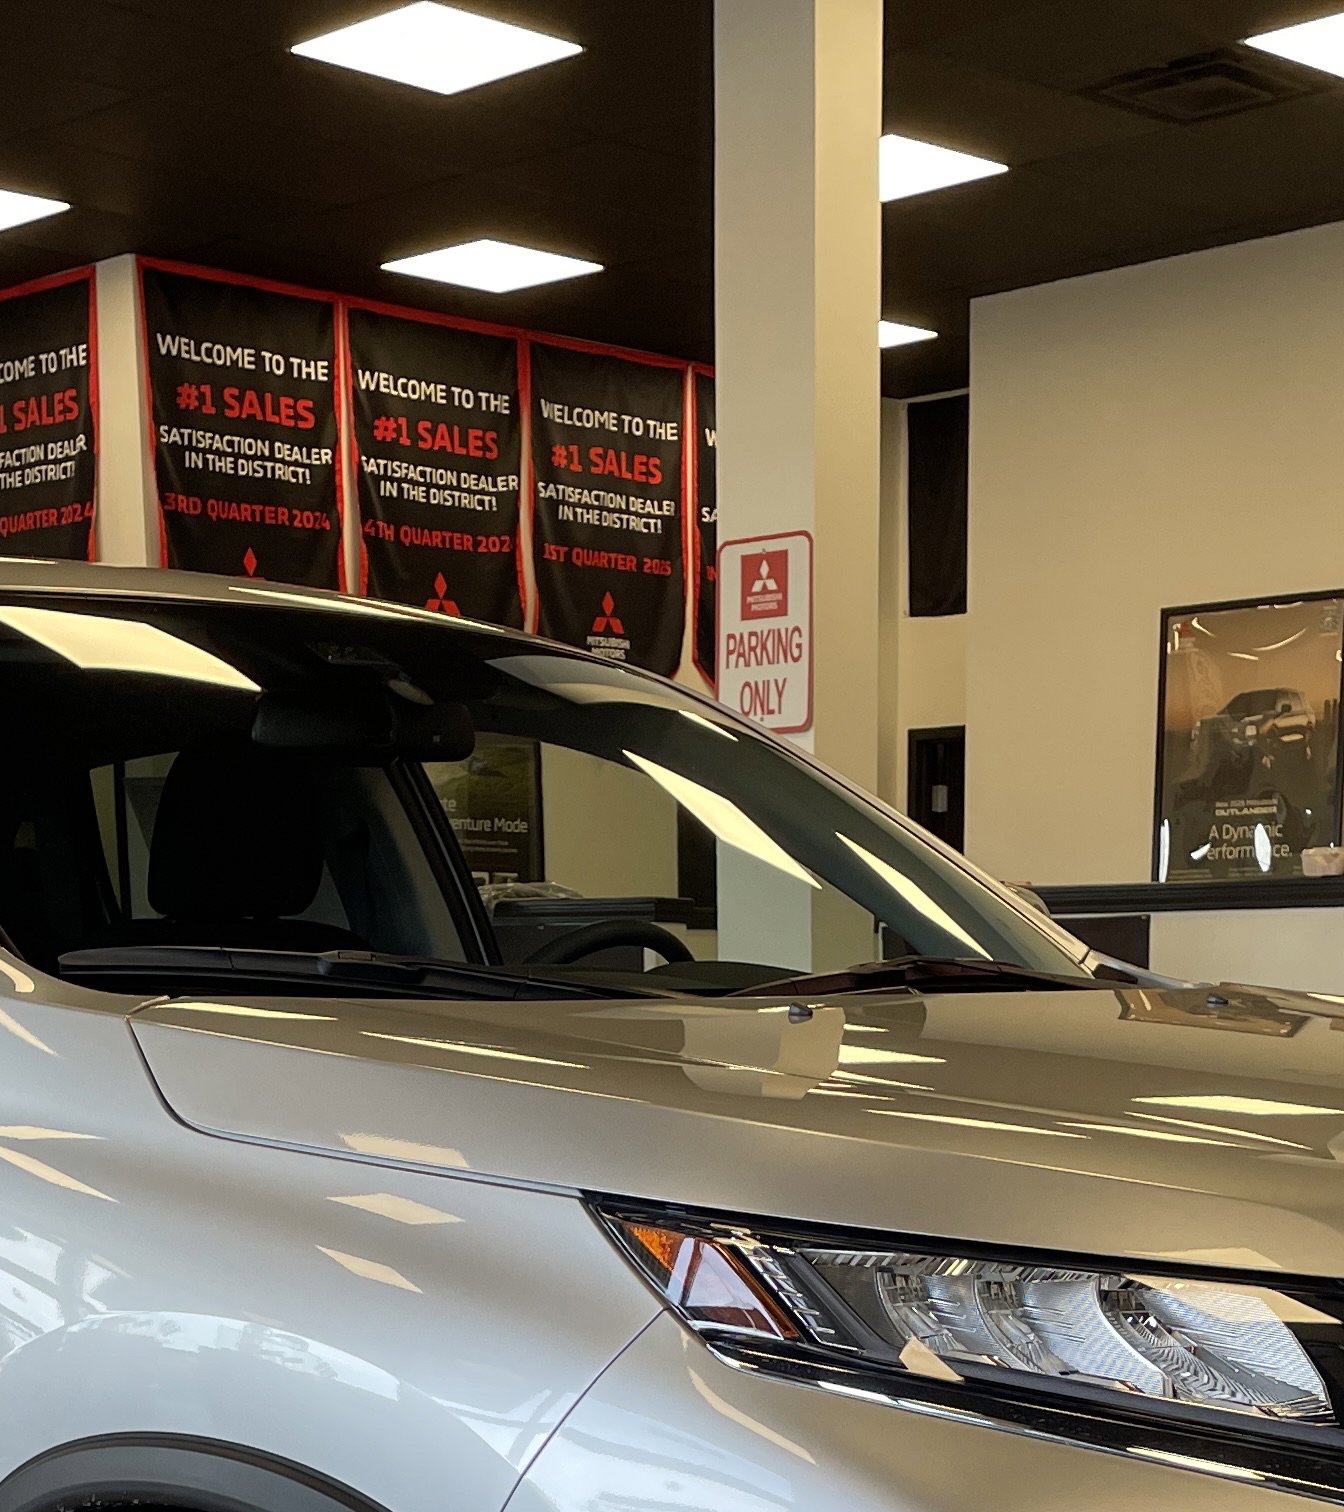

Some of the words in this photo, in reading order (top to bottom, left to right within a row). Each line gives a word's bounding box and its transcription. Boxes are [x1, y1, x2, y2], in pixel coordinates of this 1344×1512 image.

[39, 351, 57, 375] TO
[59, 343, 88, 371] THE
[156, 332, 256, 370] WELCOME
[261, 350, 285, 376] TO
[289, 356, 329, 382] THE
[12, 387, 80, 432] SALES
[175, 382, 217, 416] #1
[223, 386, 316, 431] SALES
[357, 368, 447, 405] WELCOME
[450, 385, 475, 410] TO
[478, 390, 511, 415] THE
[372, 415, 411, 447] #1
[417, 419, 500, 461] SALES
[539, 397, 619, 433] WELCOME
[620, 414, 644, 437] TO
[646, 418, 679, 442] THE
[159, 424, 270, 458] SATISFACTION
[274, 441, 333, 466] DEALER
[0, 469, 23, 490] THE
[185, 450, 203, 470] IN
[205, 454, 235, 475] THE
[237, 458, 312, 485] DISTRICT!
[360, 454, 458, 487] SATISFACTION
[460, 471, 520, 493] DEALER
[550, 443, 583, 473] #1
[590, 444, 664, 487] SALES
[163, 491, 203, 515] 3RD
[206, 498, 289, 526] QUARTER
[379, 479, 398, 499] IN
[401, 483, 428, 504] THE
[429, 487, 498, 512] DISTRICT!
[536, 480, 627, 510] SATISFACTION
[363, 518, 396, 542] 4TH
[399, 525, 473, 552] QUARTER
[477, 535, 514, 553] 202
[557, 504, 575, 522] IN
[574, 507, 601, 527] THE
[600, 510, 664, 535] DISTRICT!
[542, 541, 568, 563] 1ST
[571, 546, 638, 573] QUARTER
[725, 625, 804, 670] PARKING
[739, 676, 788, 718] ONLY
[493, 816, 528, 833] Mode
[1208, 825, 1219, 839] A
